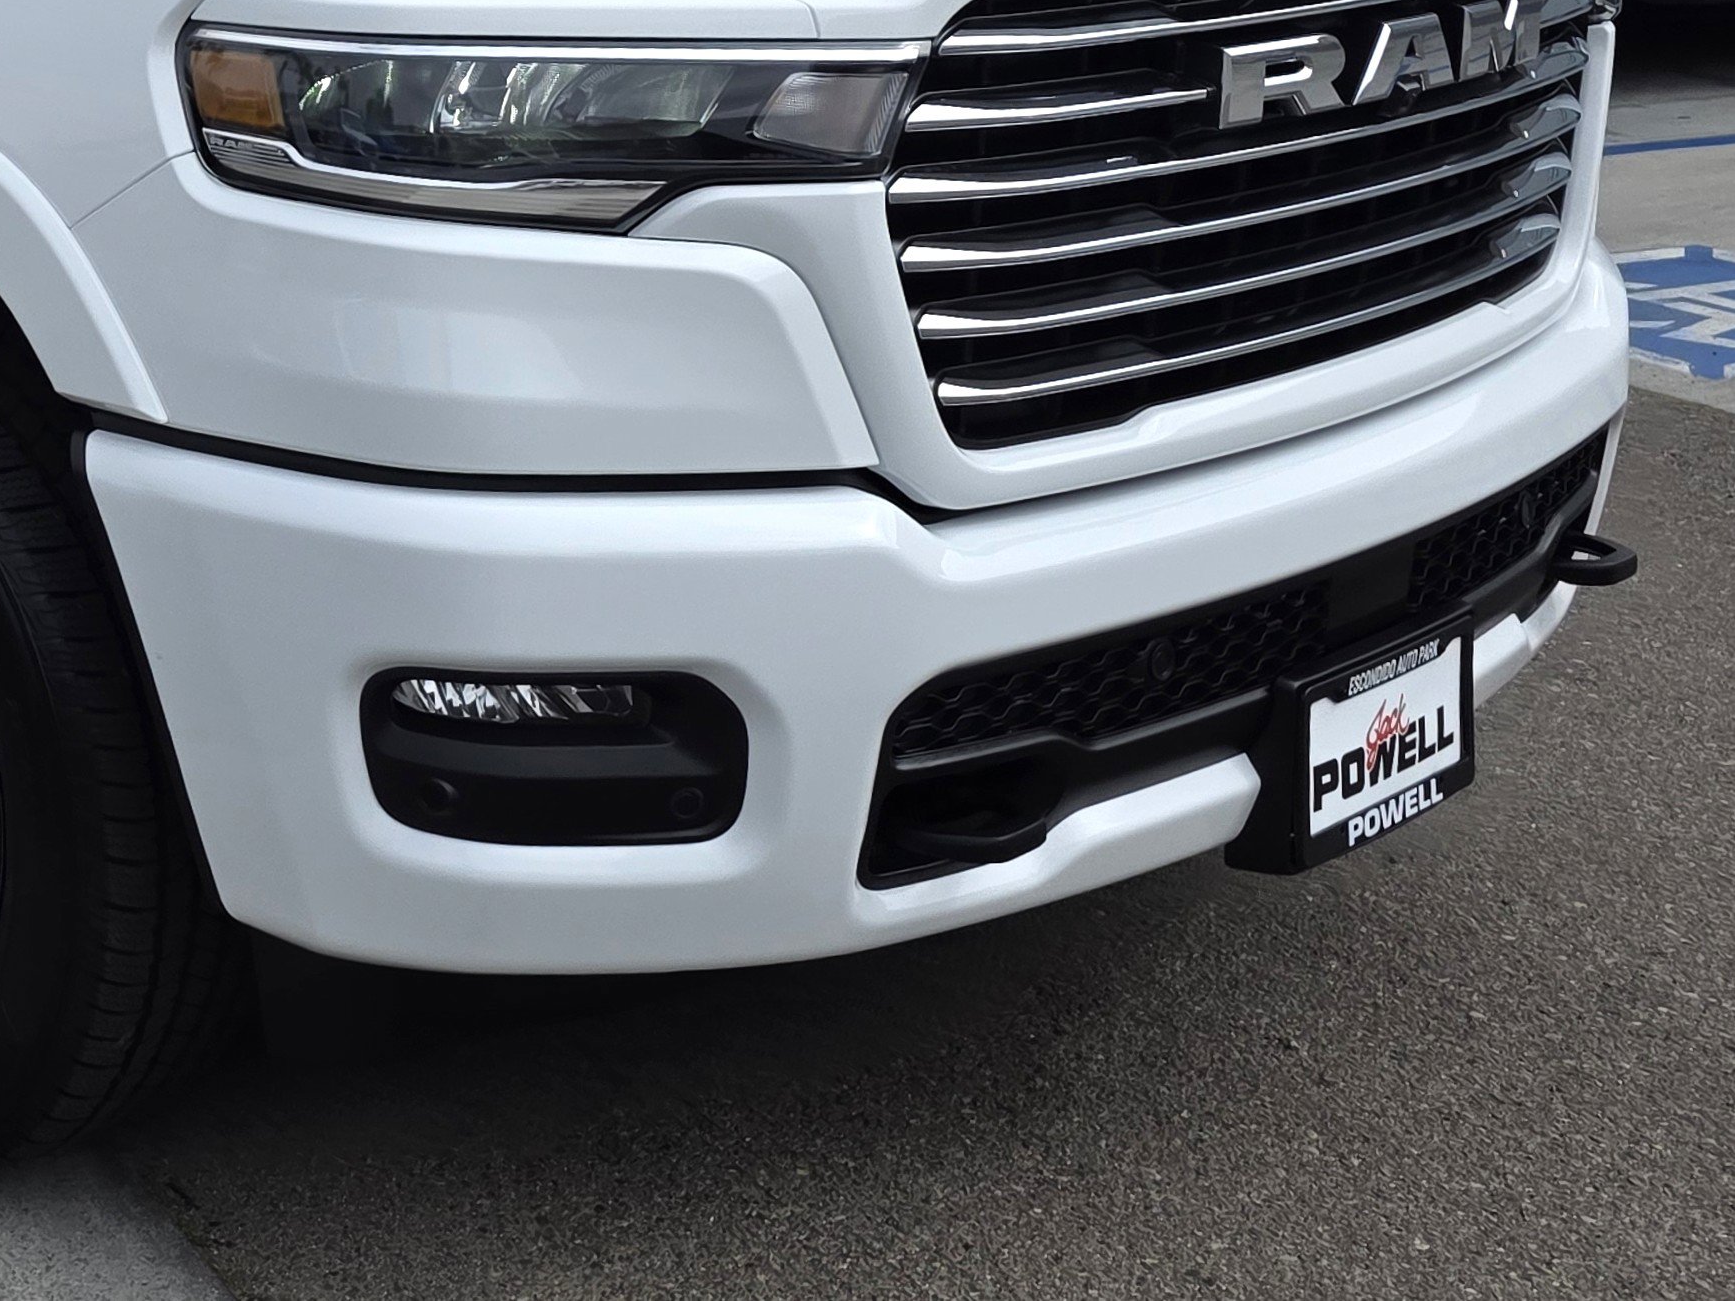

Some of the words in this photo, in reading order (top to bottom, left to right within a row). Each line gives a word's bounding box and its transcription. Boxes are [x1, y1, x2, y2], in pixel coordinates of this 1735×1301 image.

[1348, 659, 1397, 696] ESCONDIDO
[1396, 648, 1419, 675] AUTO
[1418, 638, 1440, 665] PARK
[1312, 705, 1455, 813] POWELL
[1366, 693, 1410, 771] Jack
[1348, 777, 1444, 847] POWELL
